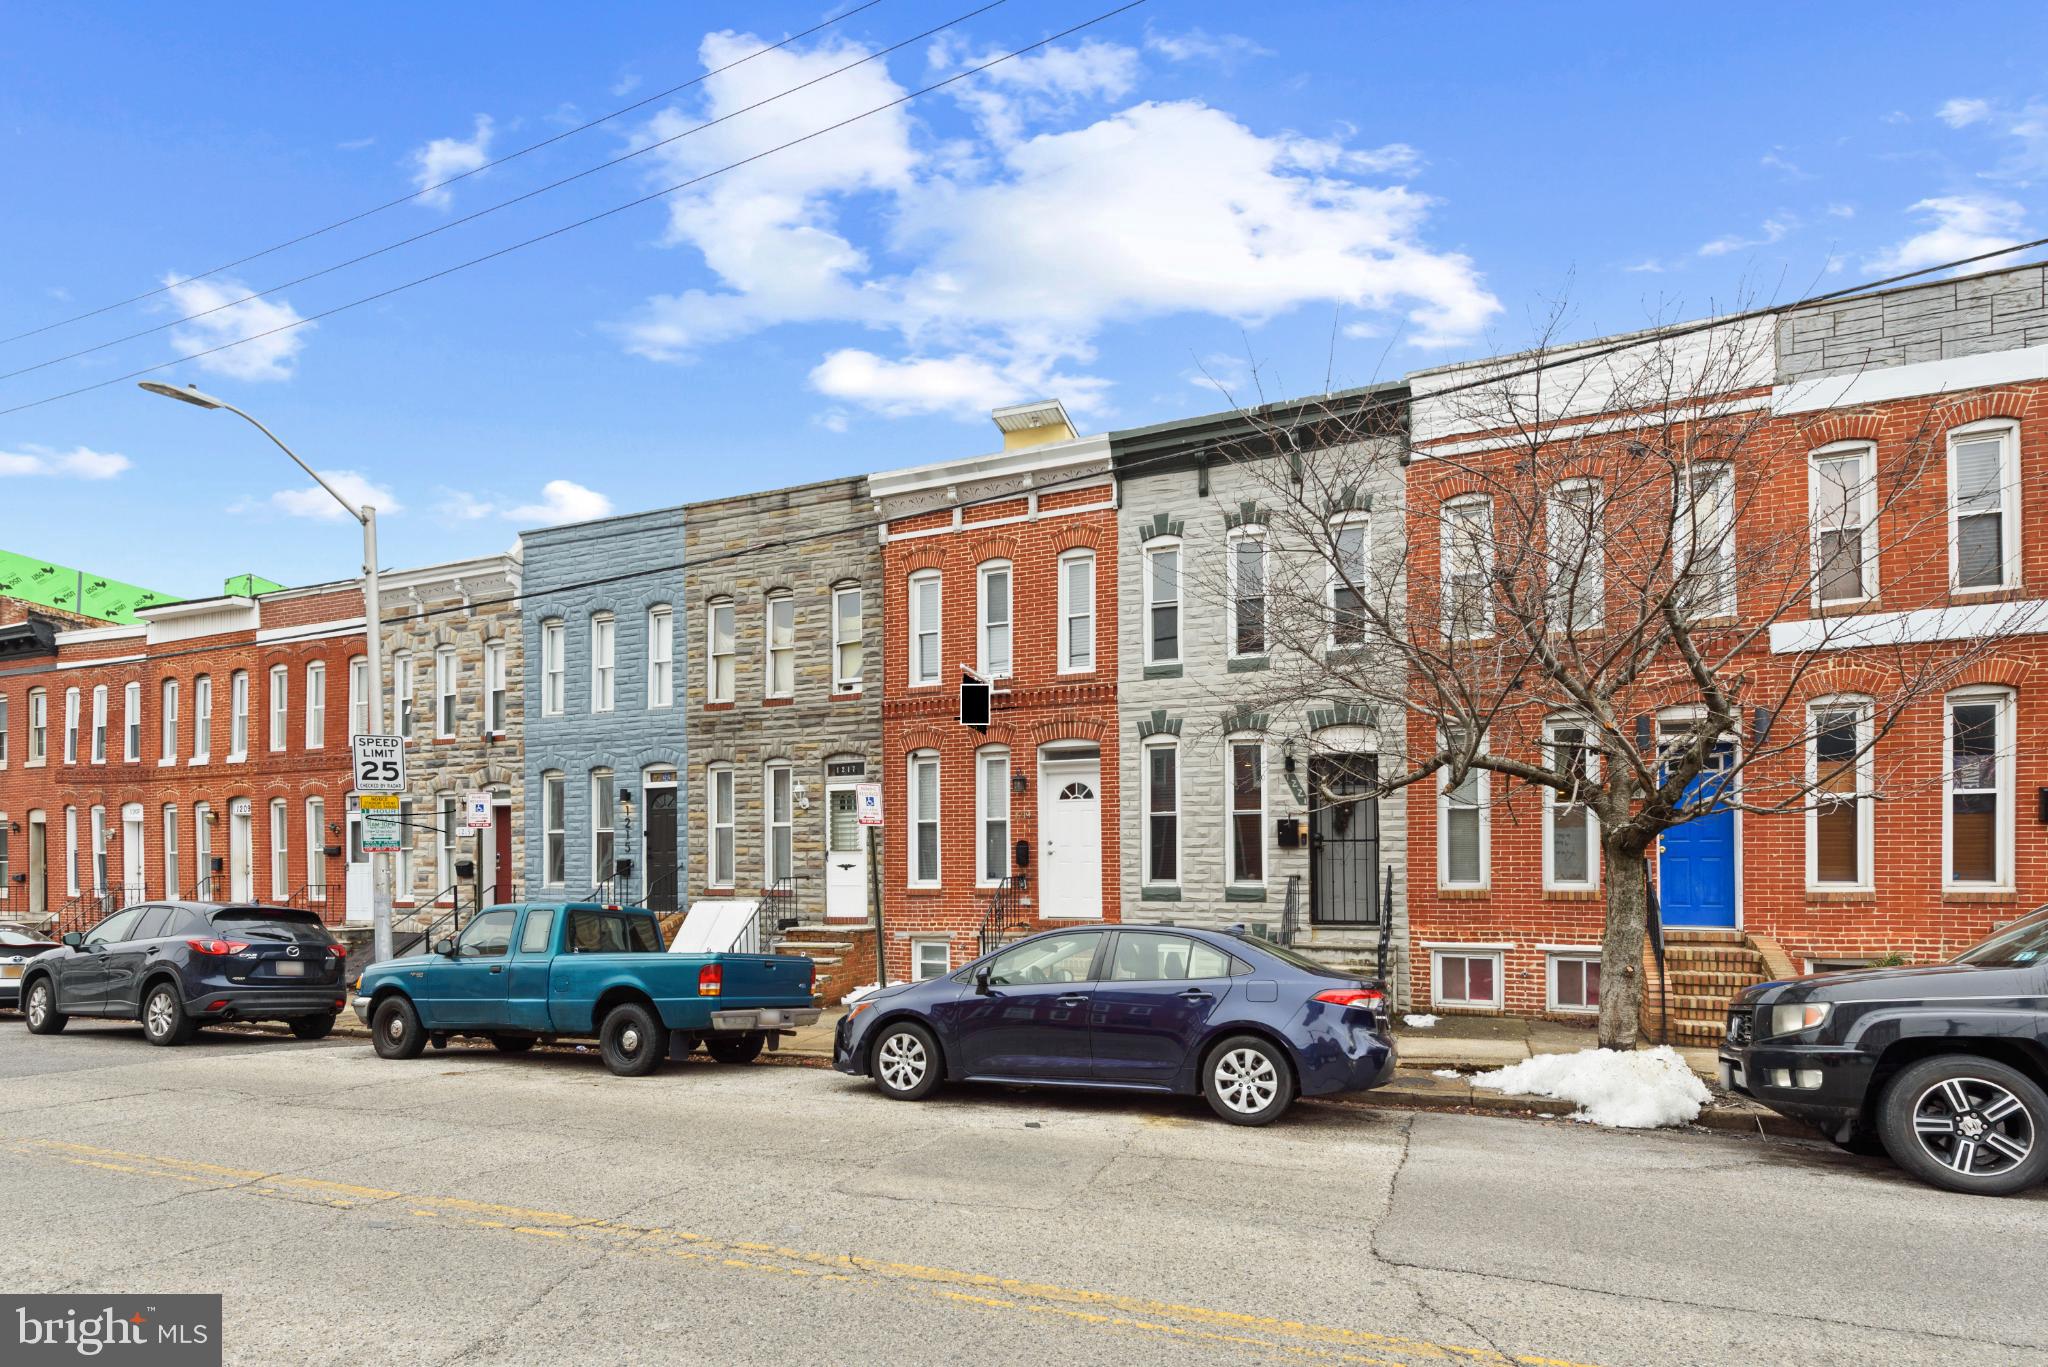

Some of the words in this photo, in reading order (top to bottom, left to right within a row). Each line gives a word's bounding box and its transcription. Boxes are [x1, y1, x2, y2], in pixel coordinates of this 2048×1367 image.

[358, 737, 399, 748] SPEED
[363, 748, 395, 758] LIMIT
[360, 760, 400, 782] 25
[836, 765, 856, 774] 1217
